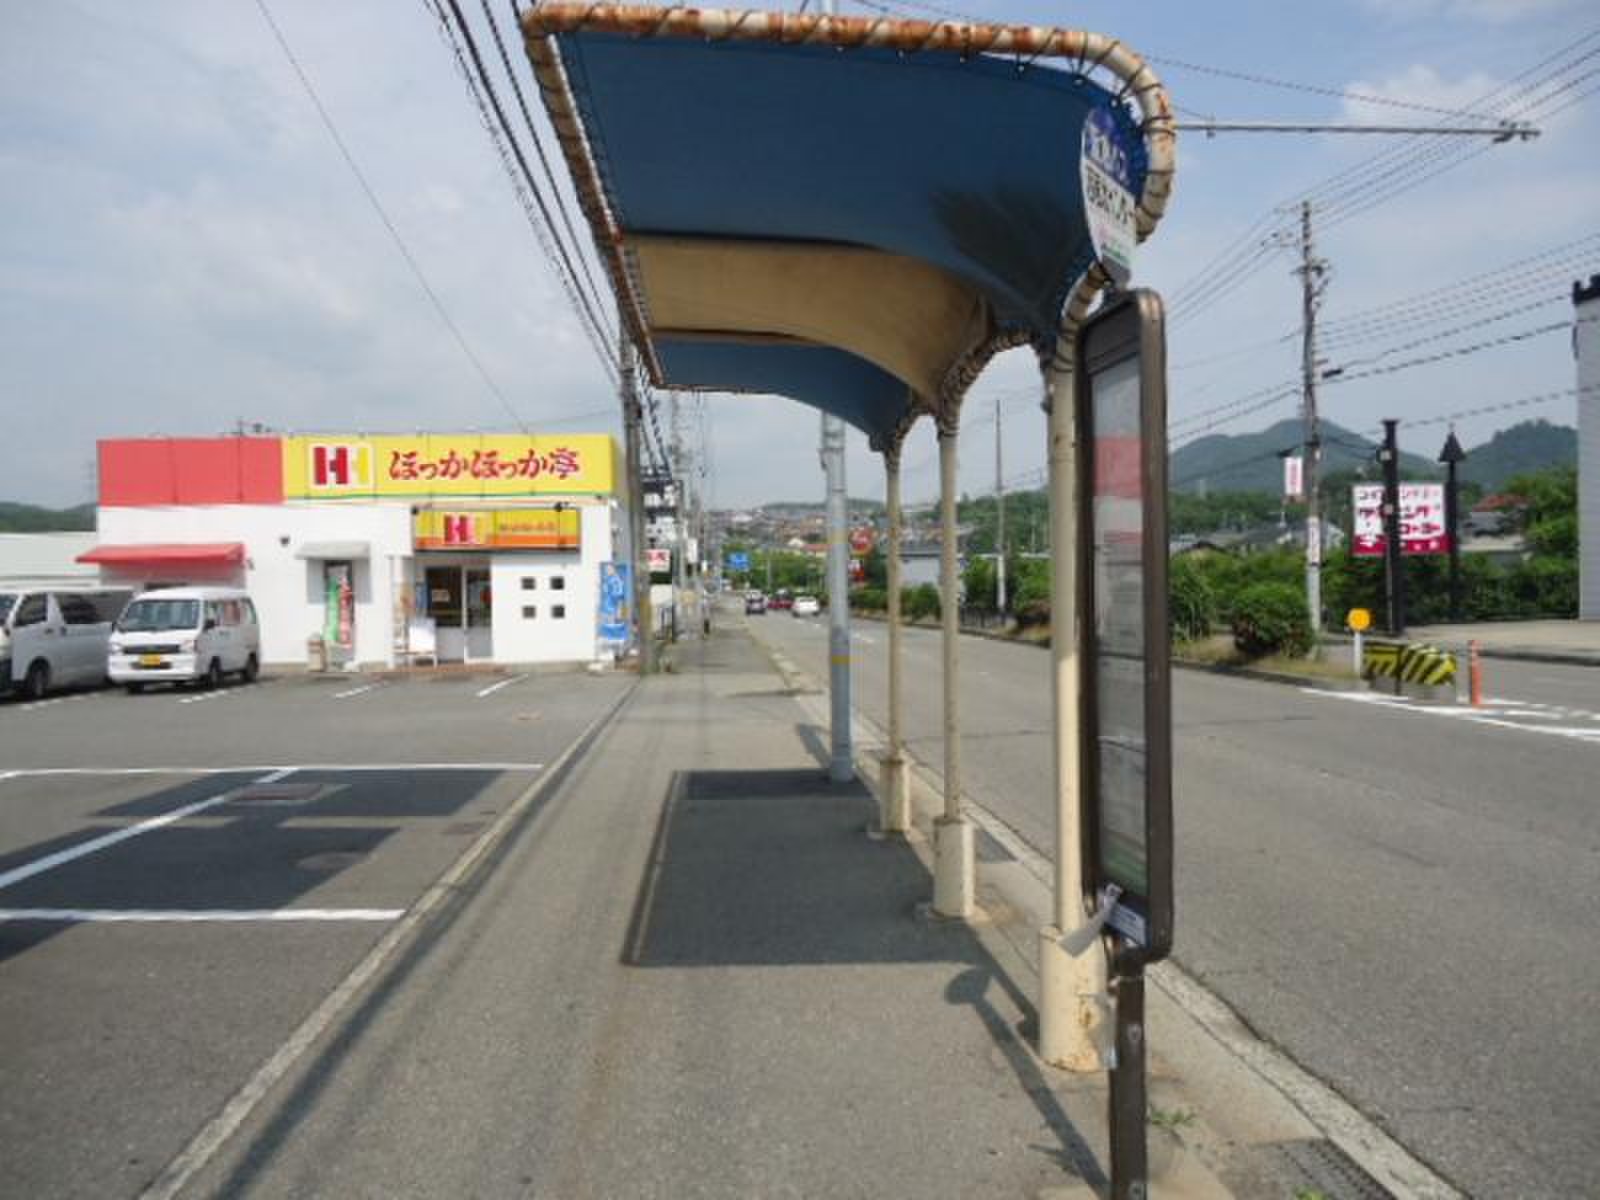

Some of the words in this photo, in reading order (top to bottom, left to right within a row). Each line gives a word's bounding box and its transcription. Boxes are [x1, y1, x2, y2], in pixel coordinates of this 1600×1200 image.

[389, 448, 581, 480] ほっかほっか亭
